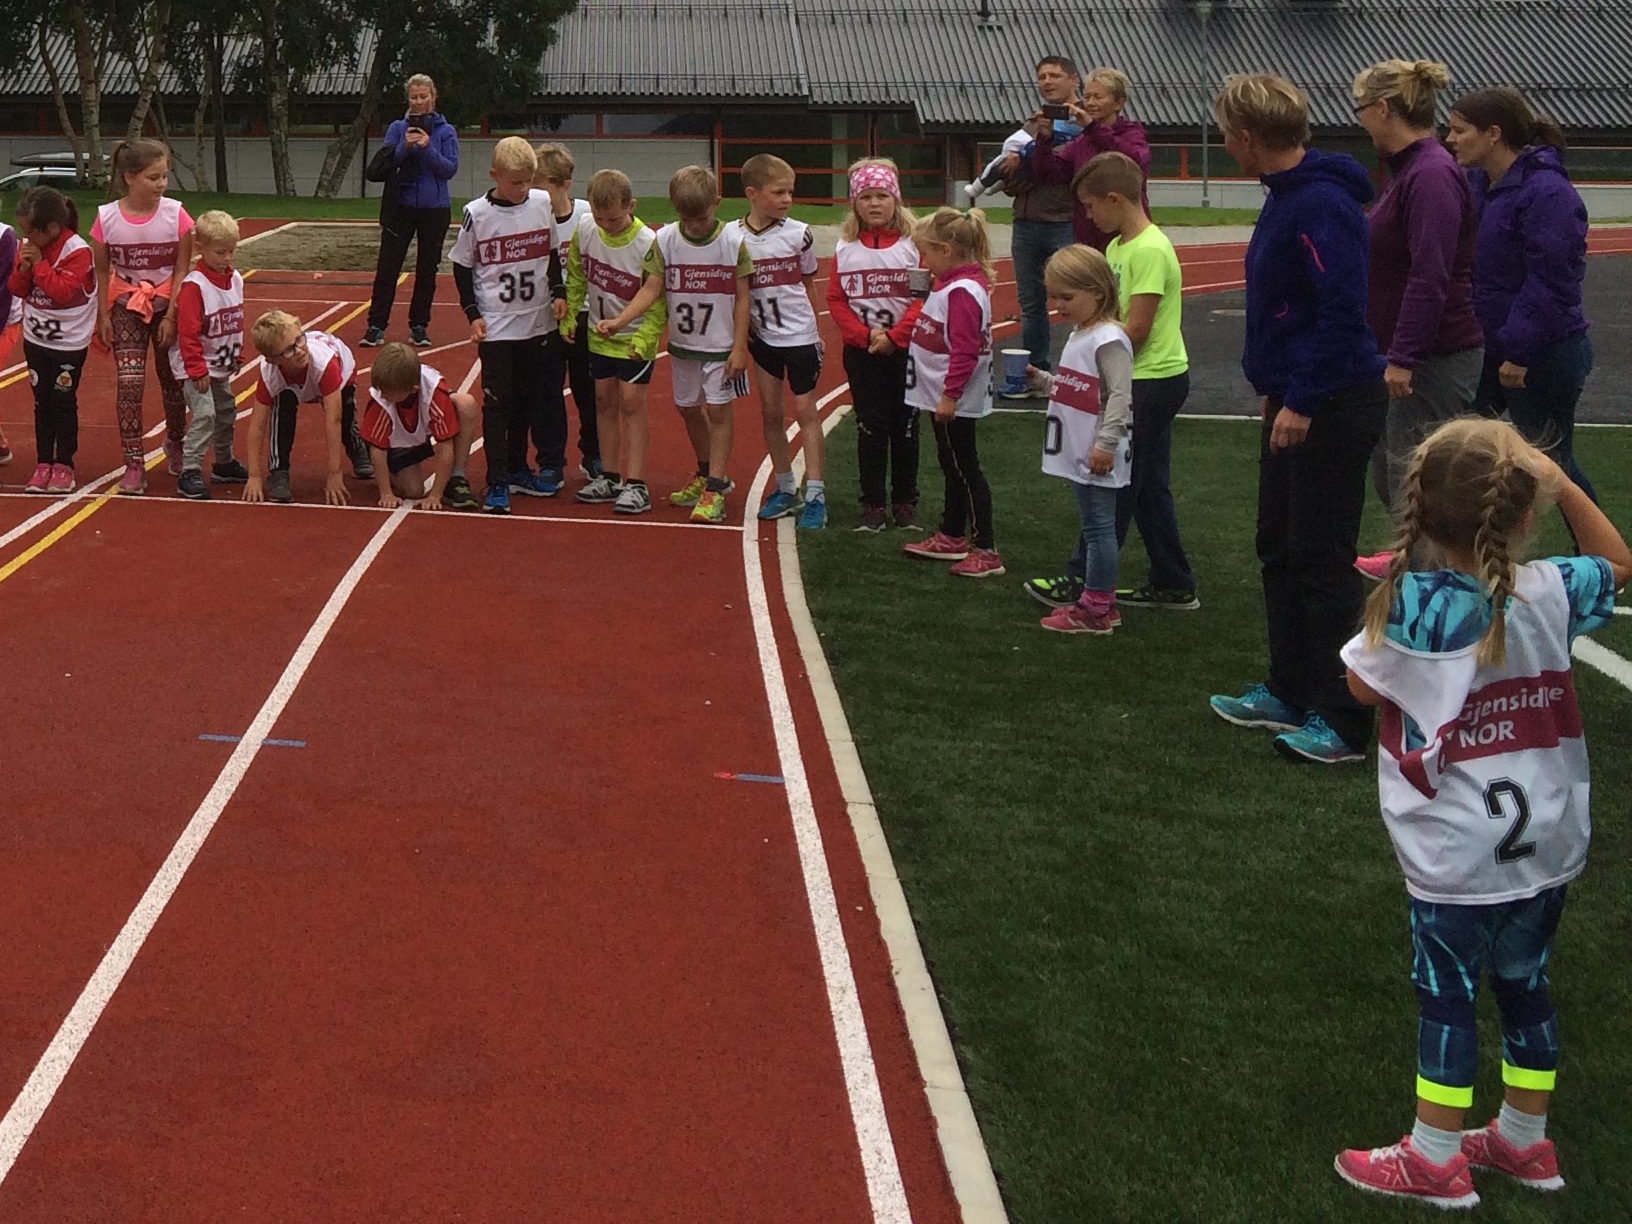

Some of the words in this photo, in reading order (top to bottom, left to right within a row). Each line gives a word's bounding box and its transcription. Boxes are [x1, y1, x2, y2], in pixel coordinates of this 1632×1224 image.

[505, 234, 548, 250] Gjensidige
[506, 248, 527, 259] NOR
[128, 257, 149, 266] NOR
[684, 269, 733, 281] Gjensidige
[866, 273, 909, 285] Gjensidi
[498, 270, 535, 303] 35
[685, 281, 707, 290] NOR
[868, 284, 891, 294] NOR
[676, 302, 714, 336] 37
[1459, 720, 1516, 748] NOR
[1483, 776, 1537, 865] 2
